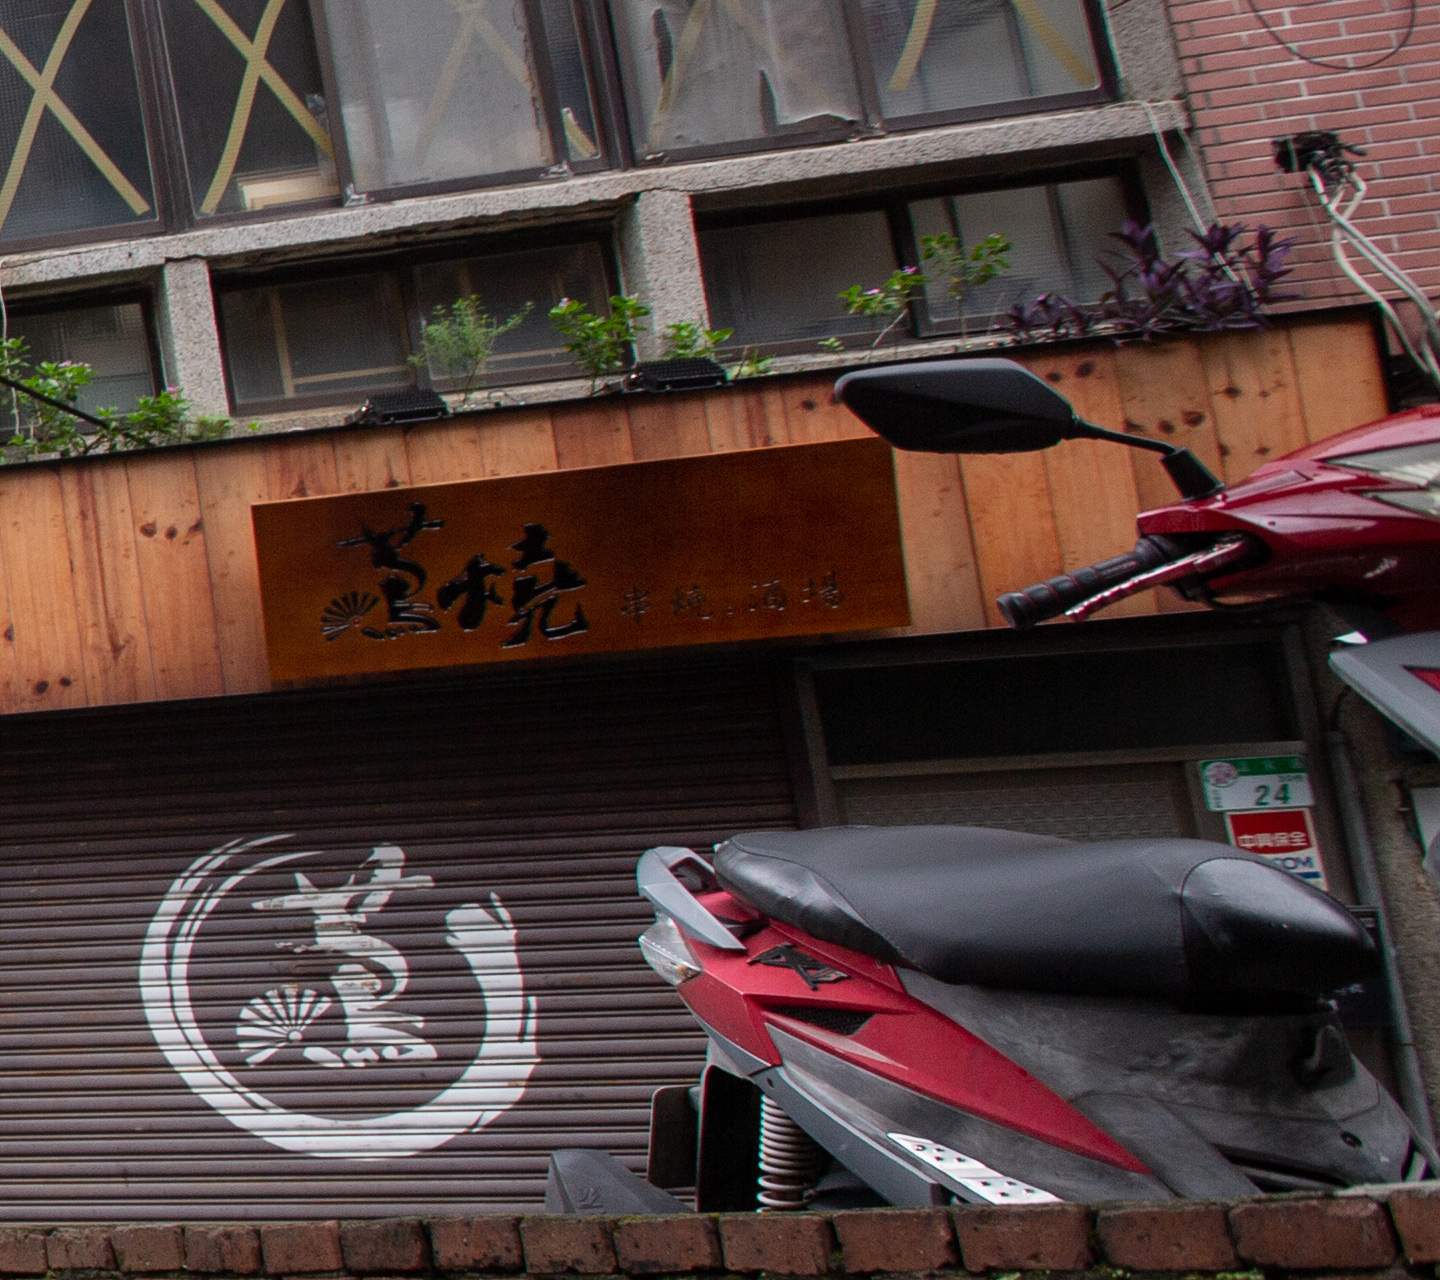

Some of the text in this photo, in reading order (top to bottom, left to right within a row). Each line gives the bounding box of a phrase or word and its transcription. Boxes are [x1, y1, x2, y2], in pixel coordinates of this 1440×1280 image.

[1254, 783, 1291, 806] 24
[1237, 831, 1309, 848] 中興保全
